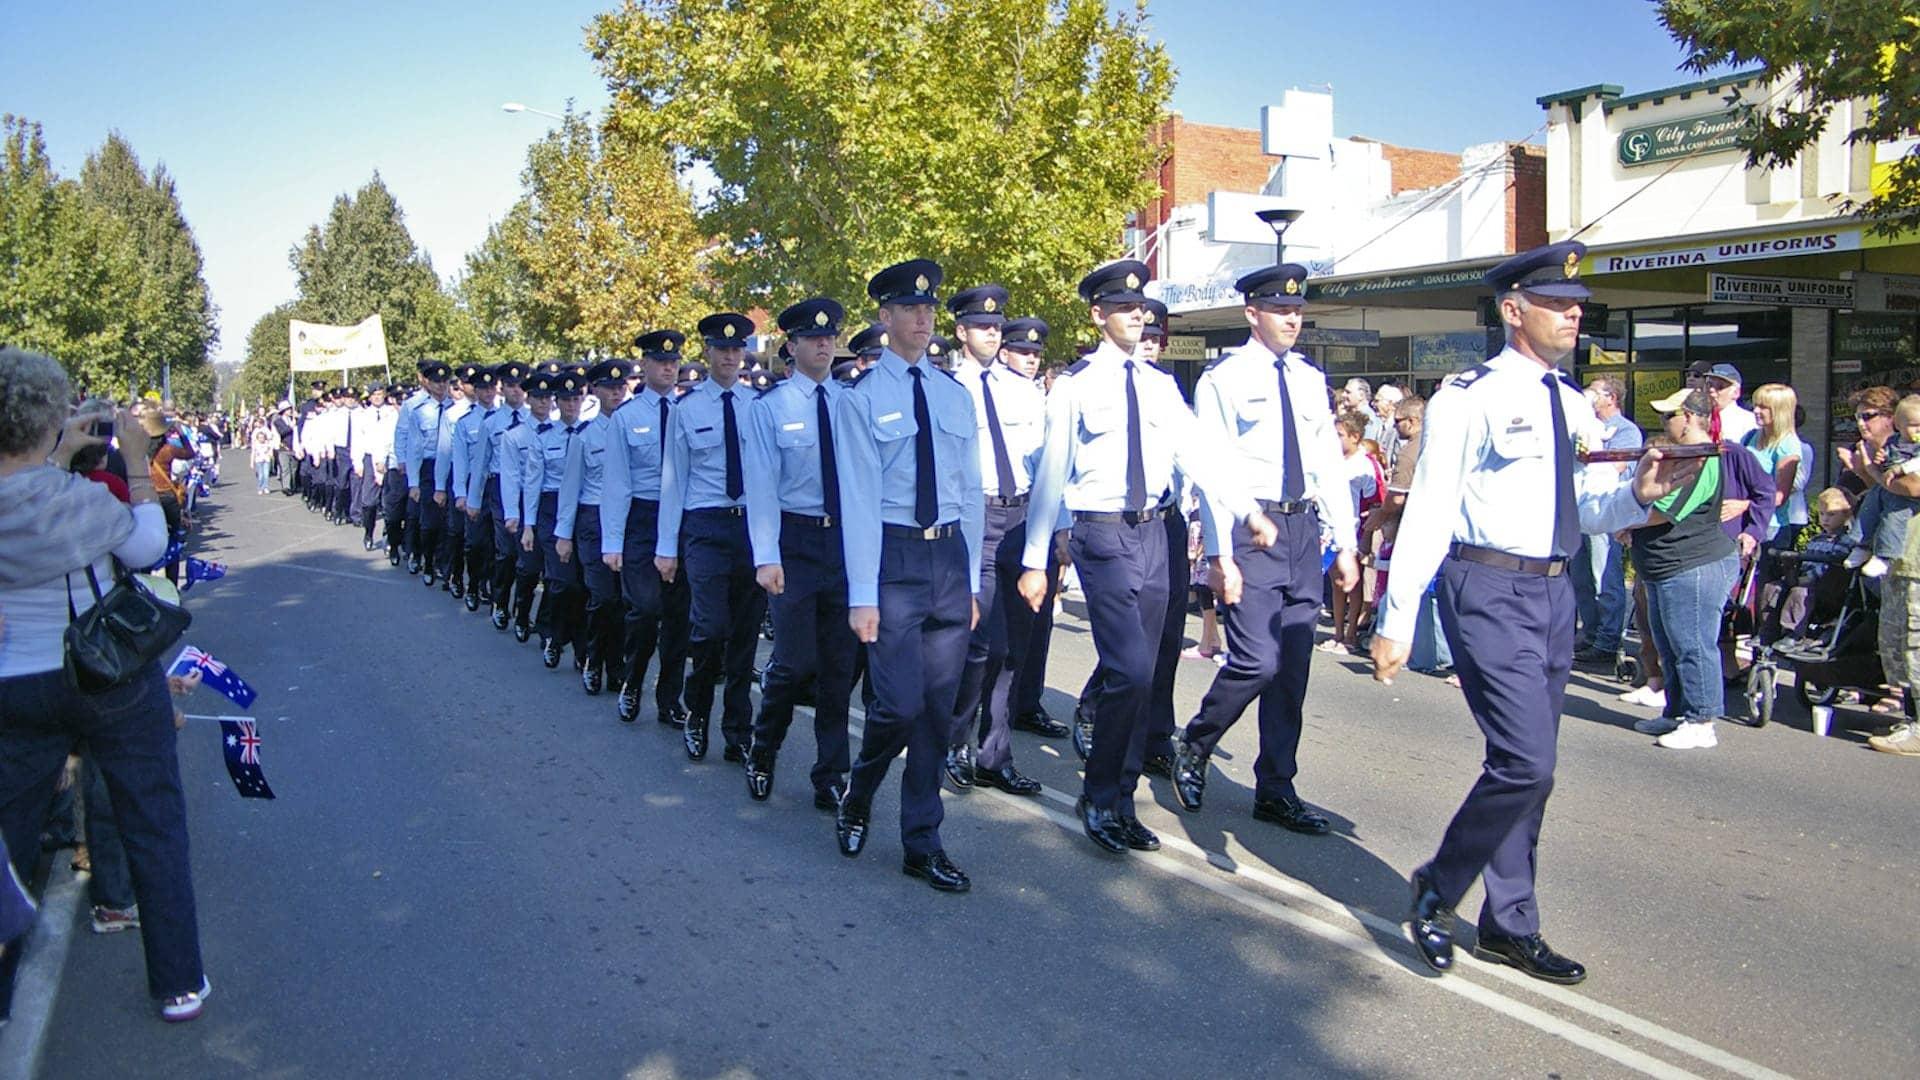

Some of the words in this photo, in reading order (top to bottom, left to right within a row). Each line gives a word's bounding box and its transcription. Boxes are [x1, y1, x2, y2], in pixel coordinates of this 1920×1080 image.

[1656, 127, 1685, 144] City
[1656, 146, 1679, 157] LOANS
[1680, 144, 1686, 152] &
[1423, 274, 1445, 286] LOANS
[1451, 271, 1469, 283] CASH
[1161, 284, 1182, 304] The
[1185, 280, 1217, 307] Body
[1320, 282, 1349, 297] City
[1354, 277, 1418, 293] Finance
[1715, 276, 1782, 295] RIVERINA
[1788, 280, 1853, 300] UNIFORMS
[1851, 325, 1900, 337] Bernina
[1171, 339, 1202, 347] CLASSIC
[1170, 347, 1204, 356] FASHIONS
